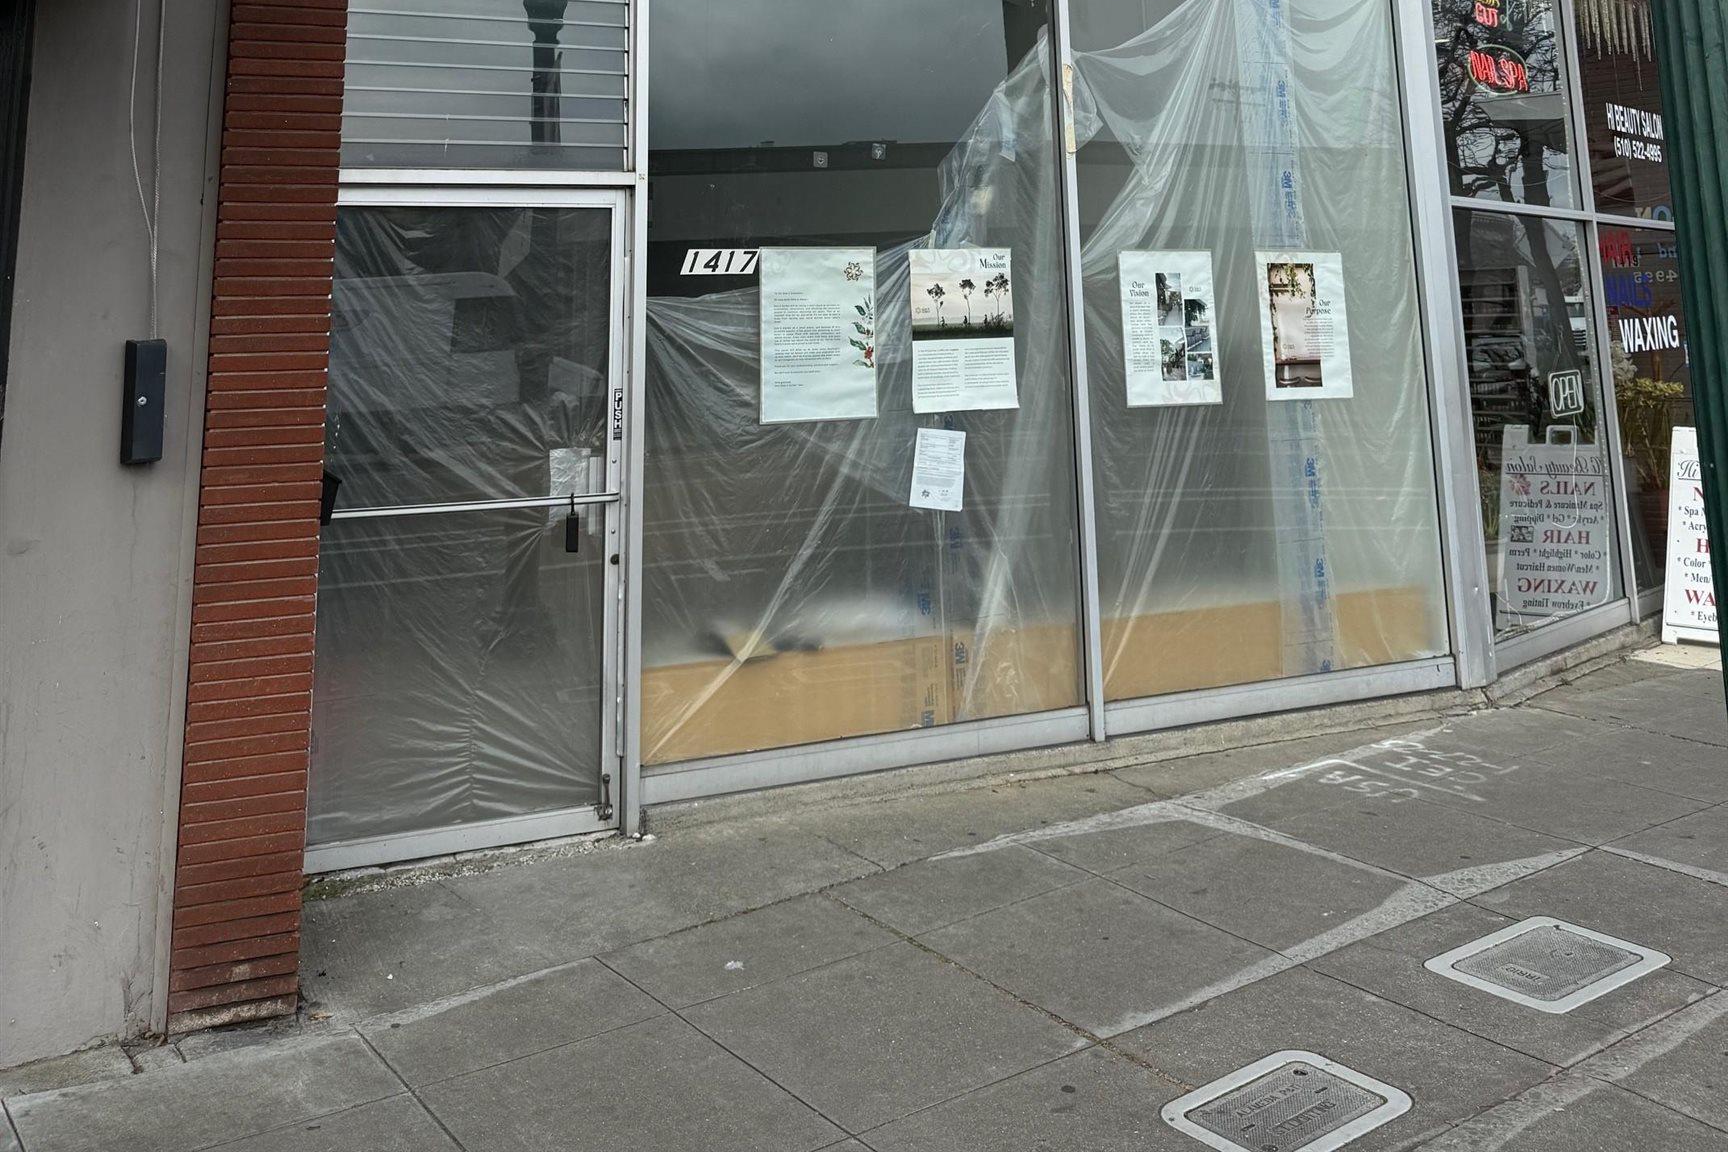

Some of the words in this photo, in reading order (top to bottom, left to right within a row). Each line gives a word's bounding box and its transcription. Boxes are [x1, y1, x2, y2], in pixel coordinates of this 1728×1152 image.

[1475, 2, 1499, 28] CUT
[1469, 50, 1503, 86] NAIL
[1498, 58, 1529, 92] SPA
[1605, 102, 1616, 131] HI
[1613, 104, 1642, 136] BEAUTY
[1640, 110, 1664, 141] SALON
[1613, 135, 1632, 160] (510)
[1632, 140, 1662, 163] 522-4995
[688, 250, 758, 273] 1417
[979, 258, 1007, 269] Mission
[992, 253, 1005, 261] Our
[1129, 289, 1150, 297] Vision
[1131, 281, 1145, 289] Our
[1305, 307, 1332, 318] Purpose
[1319, 299, 1331, 307] Our
[1618, 315, 1680, 353] WAXING
[1552, 375, 1584, 411] OPEN
[613, 391, 623, 429] PUSH
[1677, 459, 1700, 478] Hi
[1684, 506, 1699, 518] Spa
[1683, 557, 1706, 568] Color
[1235, 1095, 1280, 1116] ALAMEDA
